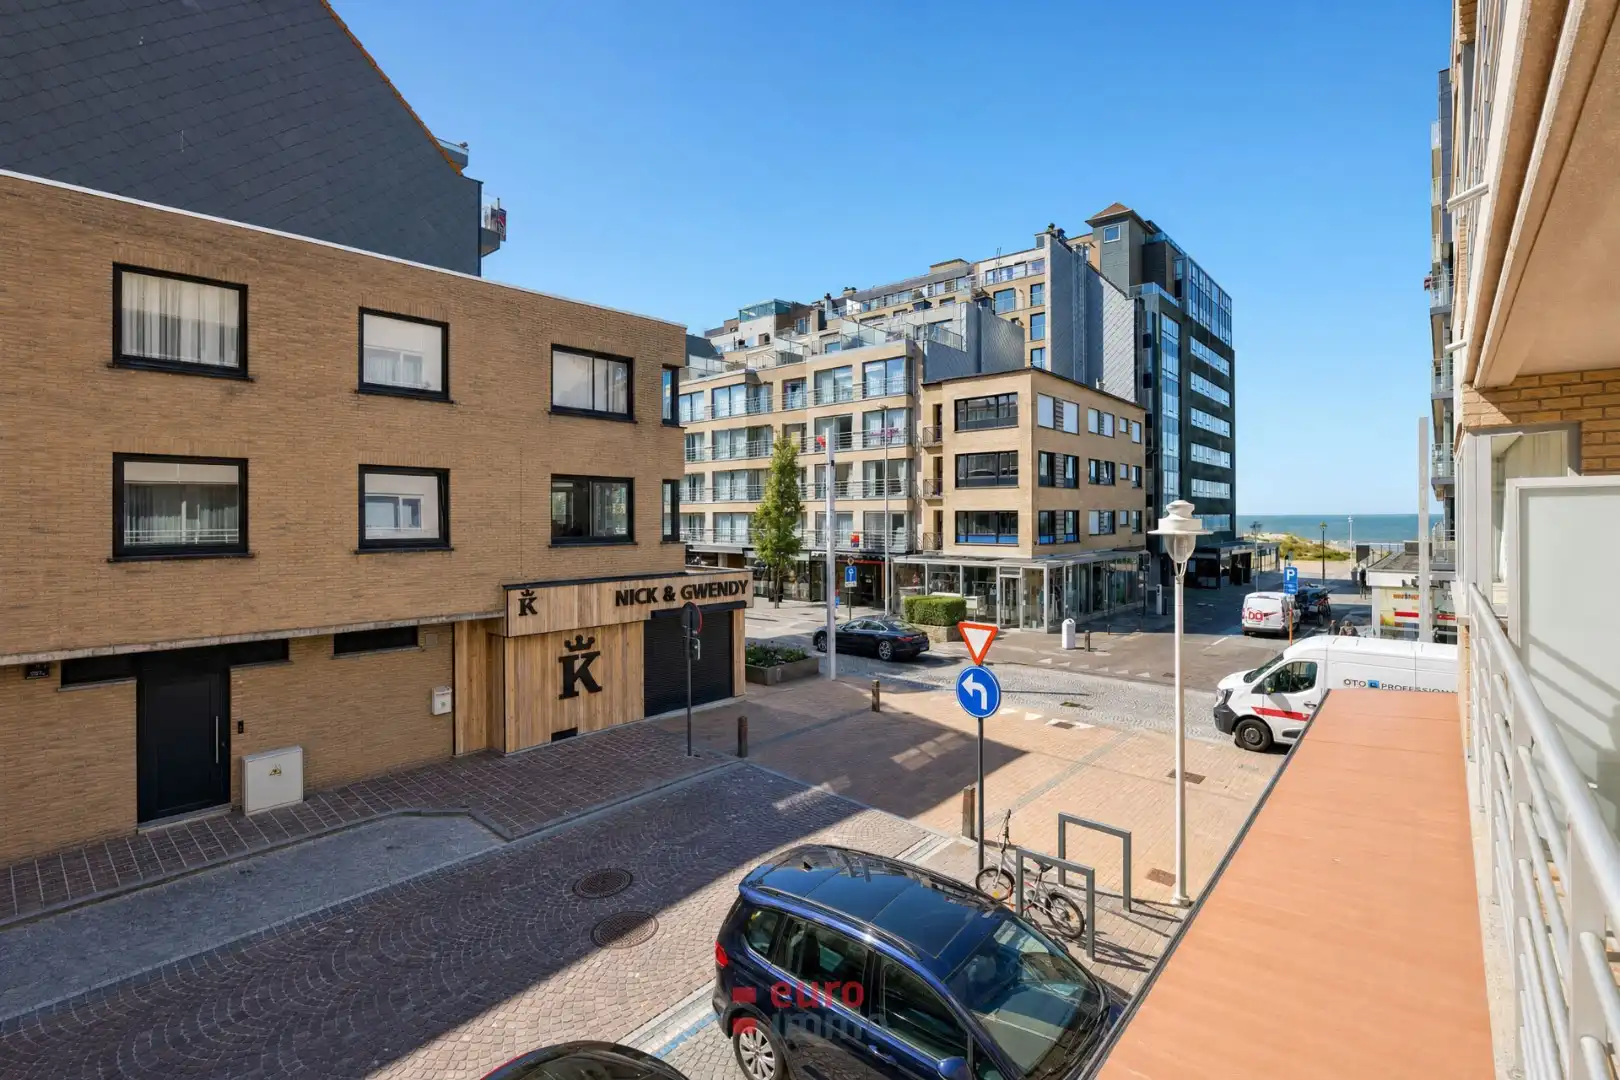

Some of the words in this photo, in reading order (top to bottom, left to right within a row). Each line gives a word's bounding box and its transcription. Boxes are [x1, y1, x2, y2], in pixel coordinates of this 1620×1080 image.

[1286, 568, 1296, 581] P
[615, 587, 659, 607] NICK
[662, 585, 676, 602] &
[680, 579, 749, 600] GWENDY
[518, 596, 538, 617] K
[558, 650, 603, 700] K
[1381, 683, 1456, 693] PROFESSI
